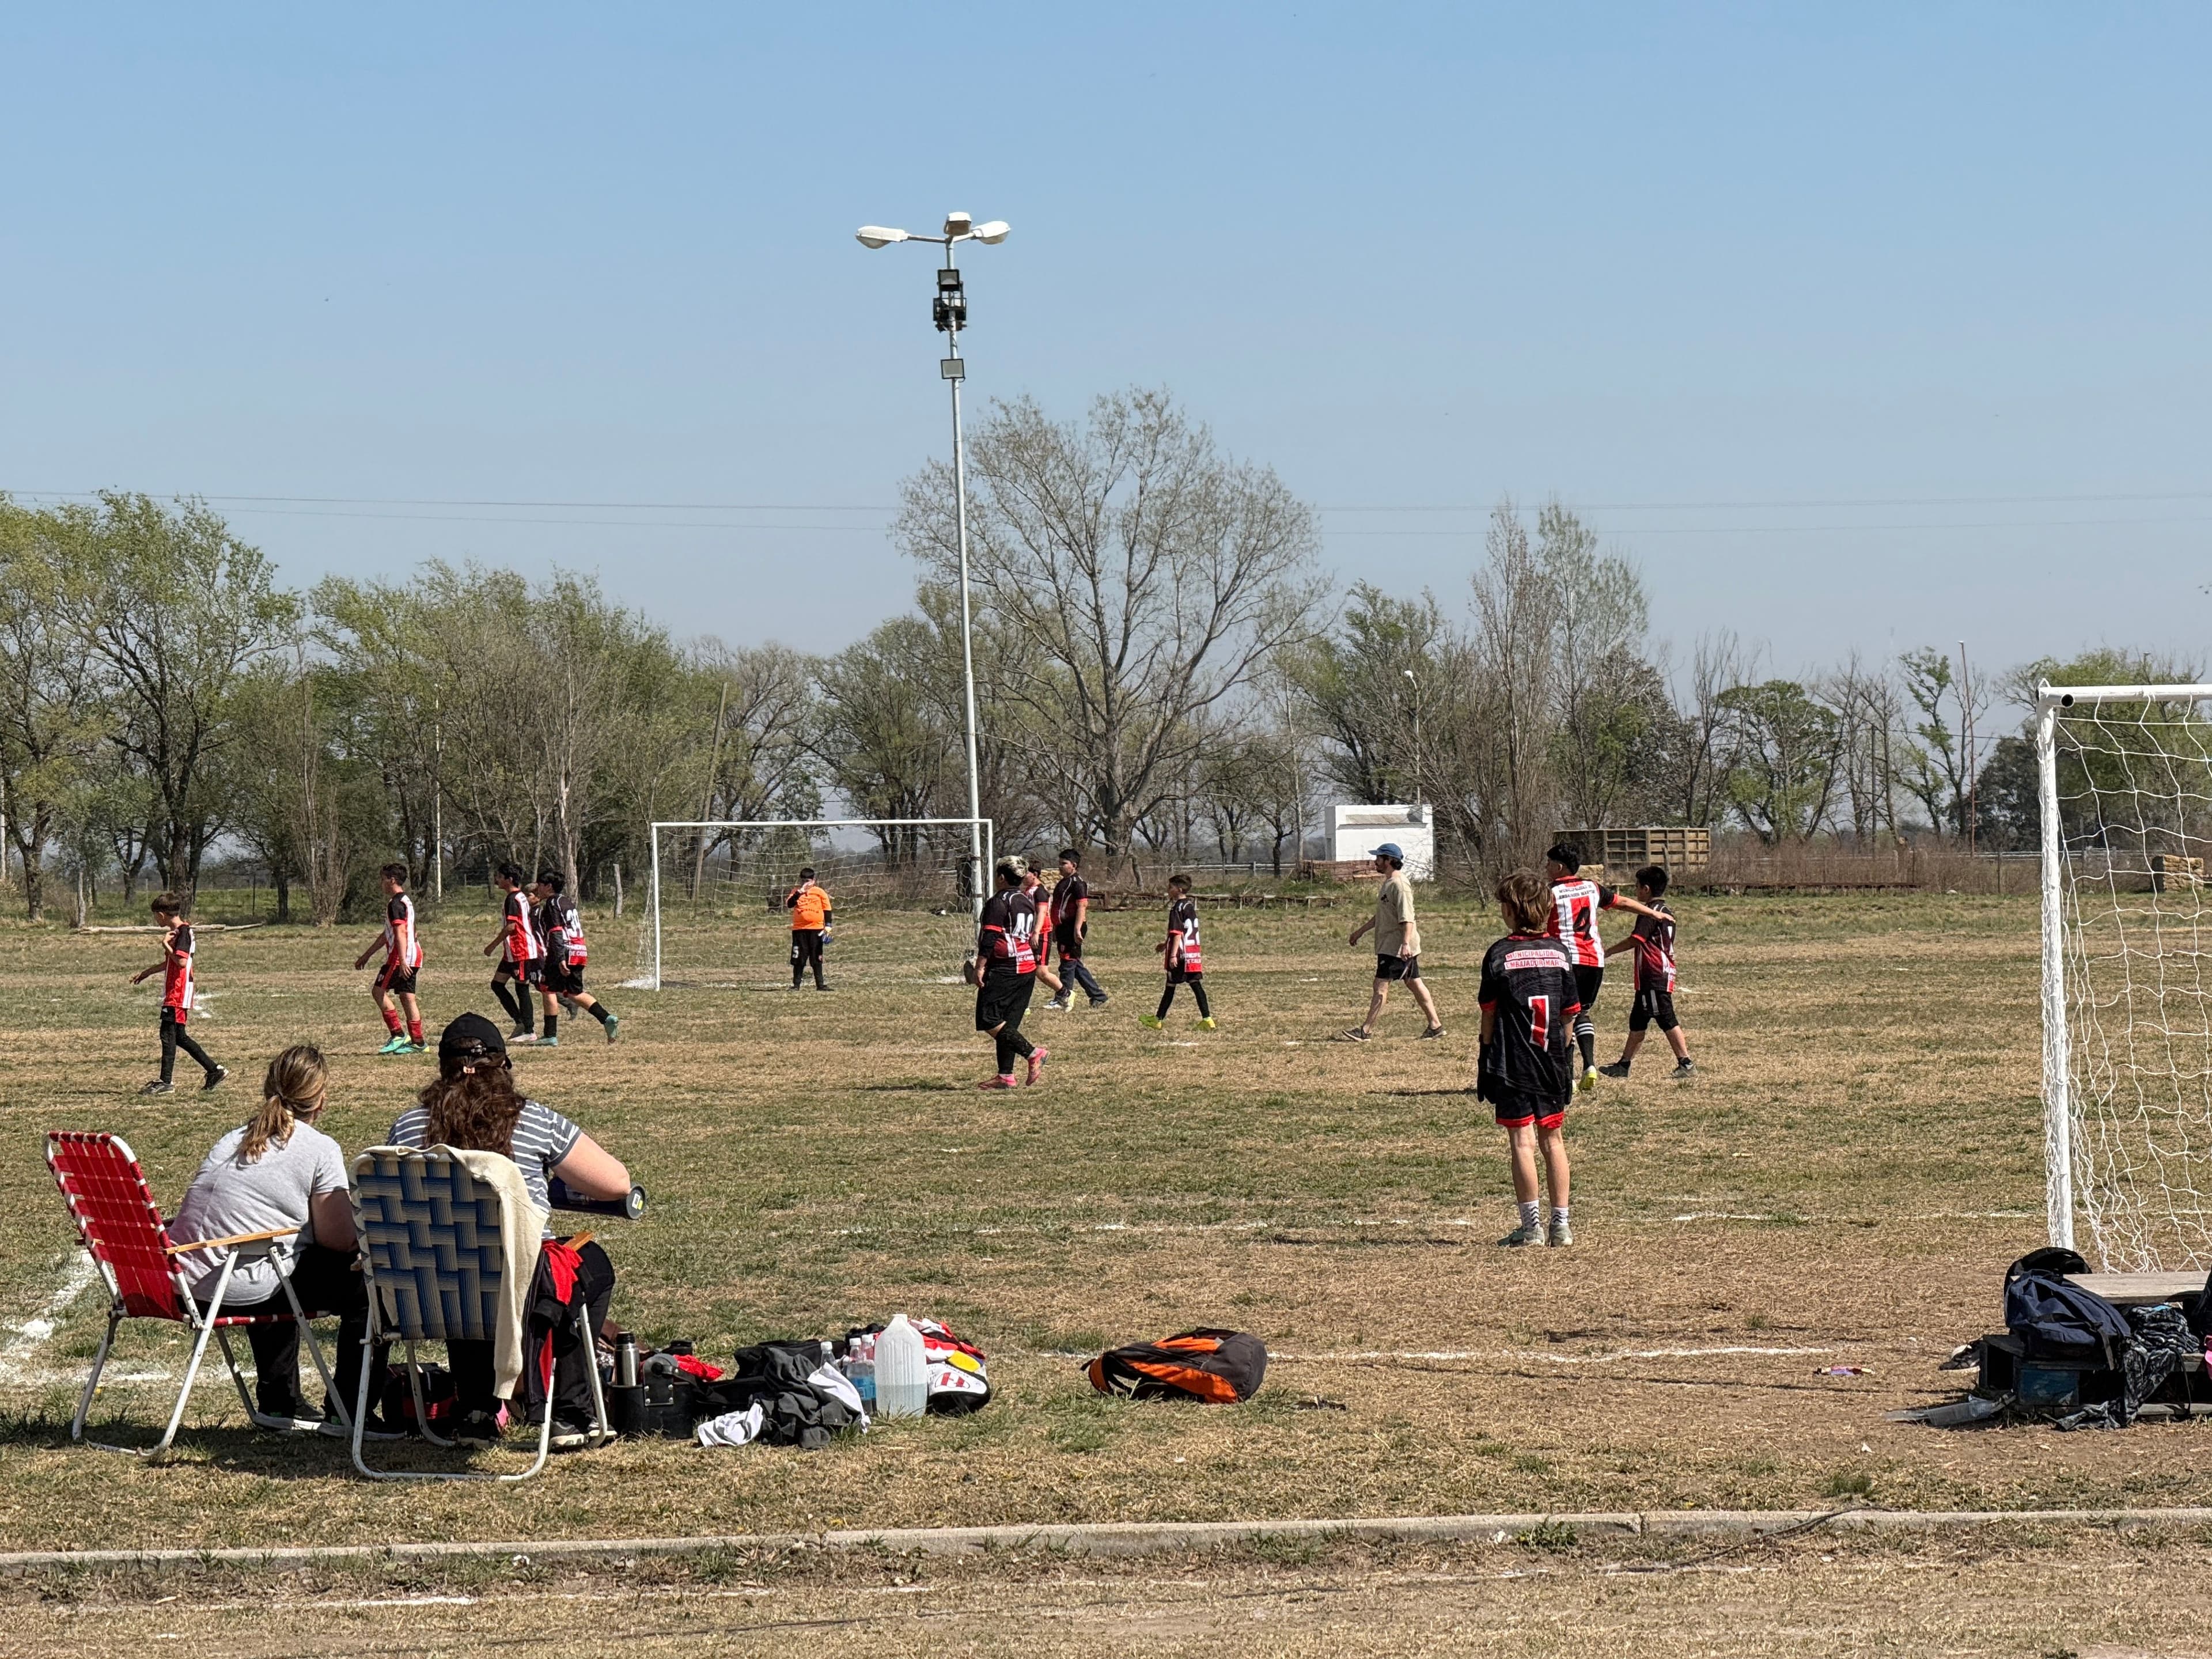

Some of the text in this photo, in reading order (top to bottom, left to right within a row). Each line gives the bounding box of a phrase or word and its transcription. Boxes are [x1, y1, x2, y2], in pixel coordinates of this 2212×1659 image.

[1572, 906, 1592, 941] 4
[1505, 959, 1544, 969] EMBAJADOR
[1528, 995, 1550, 1052] 1
